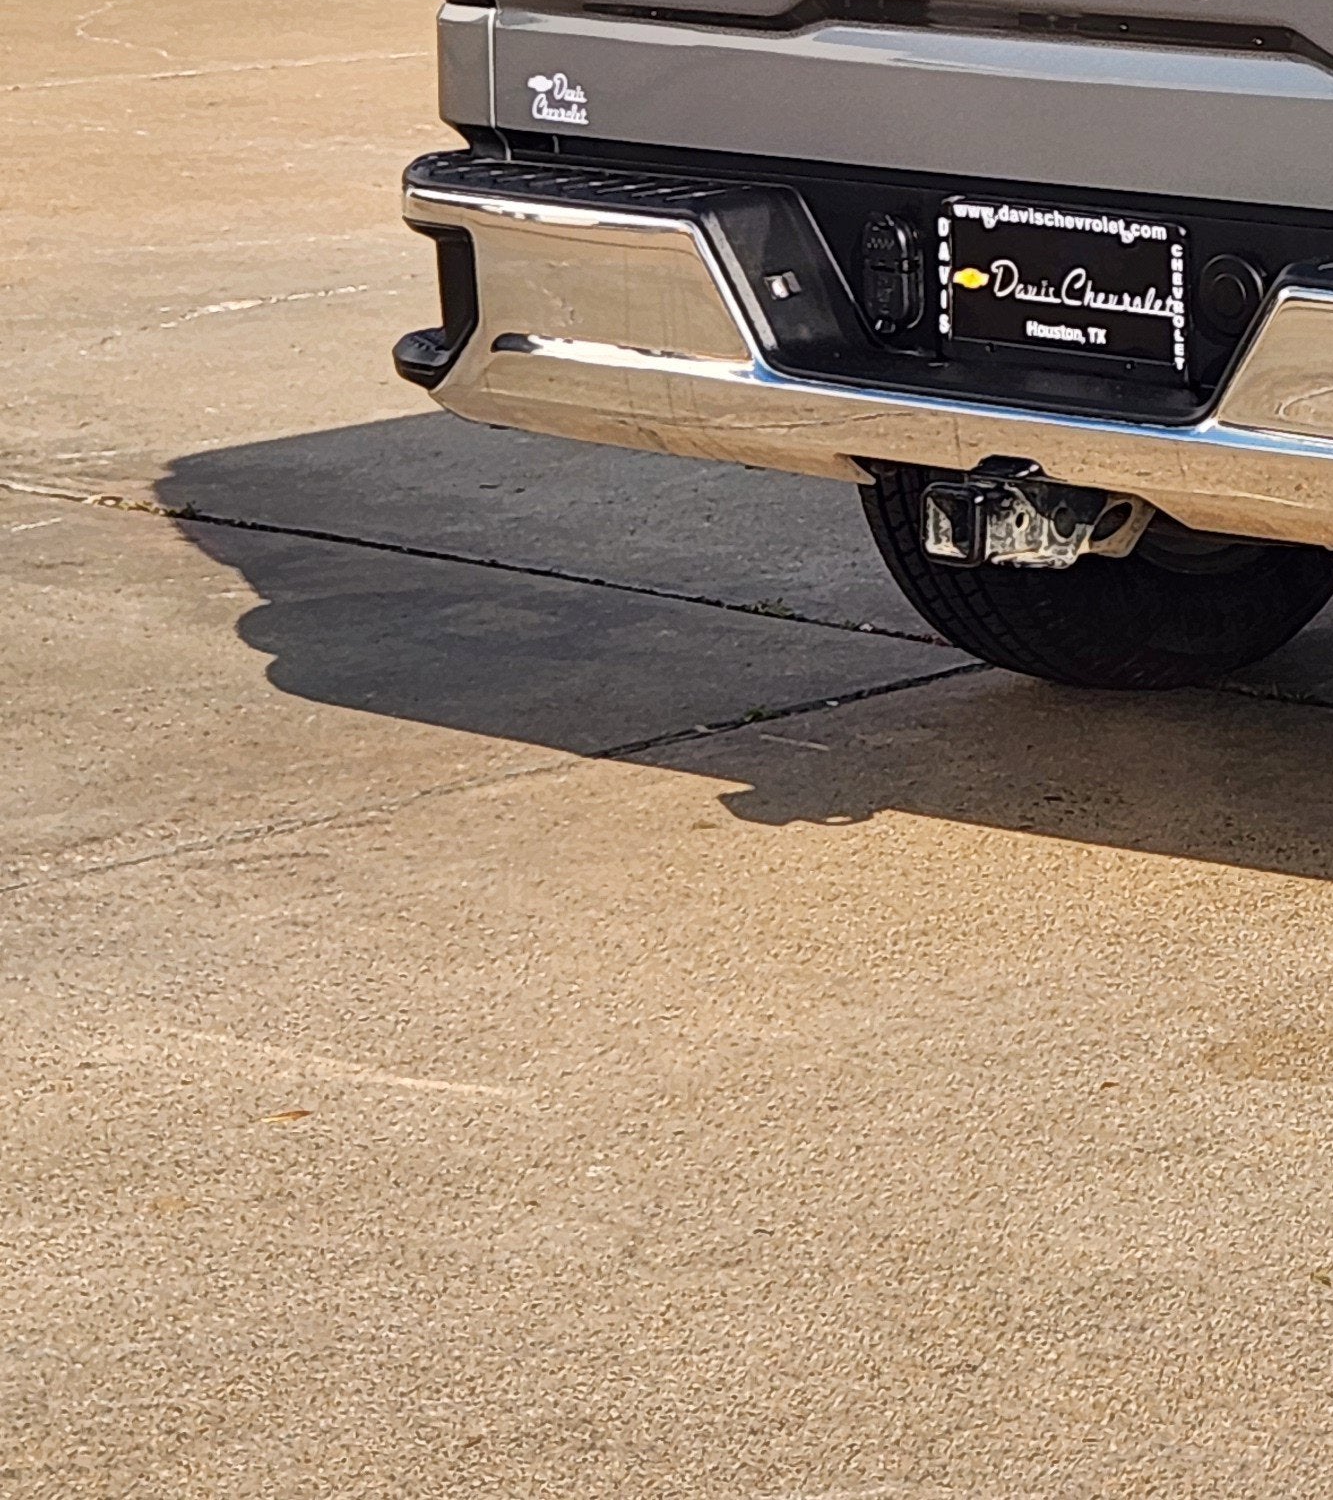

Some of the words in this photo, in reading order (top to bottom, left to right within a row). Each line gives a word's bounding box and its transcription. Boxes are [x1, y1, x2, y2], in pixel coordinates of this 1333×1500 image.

[952, 202, 1168, 242] www.davischevrolet.com
[937, 216, 951, 335] DAVIS
[990, 259, 1061, 305] Davis
[1061, 267, 1174, 318] Chevrolet
[1170, 243, 1186, 371] CHEVROLET
[1026, 319, 1086, 345] Houston,
[1087, 325, 1107, 344] TX
